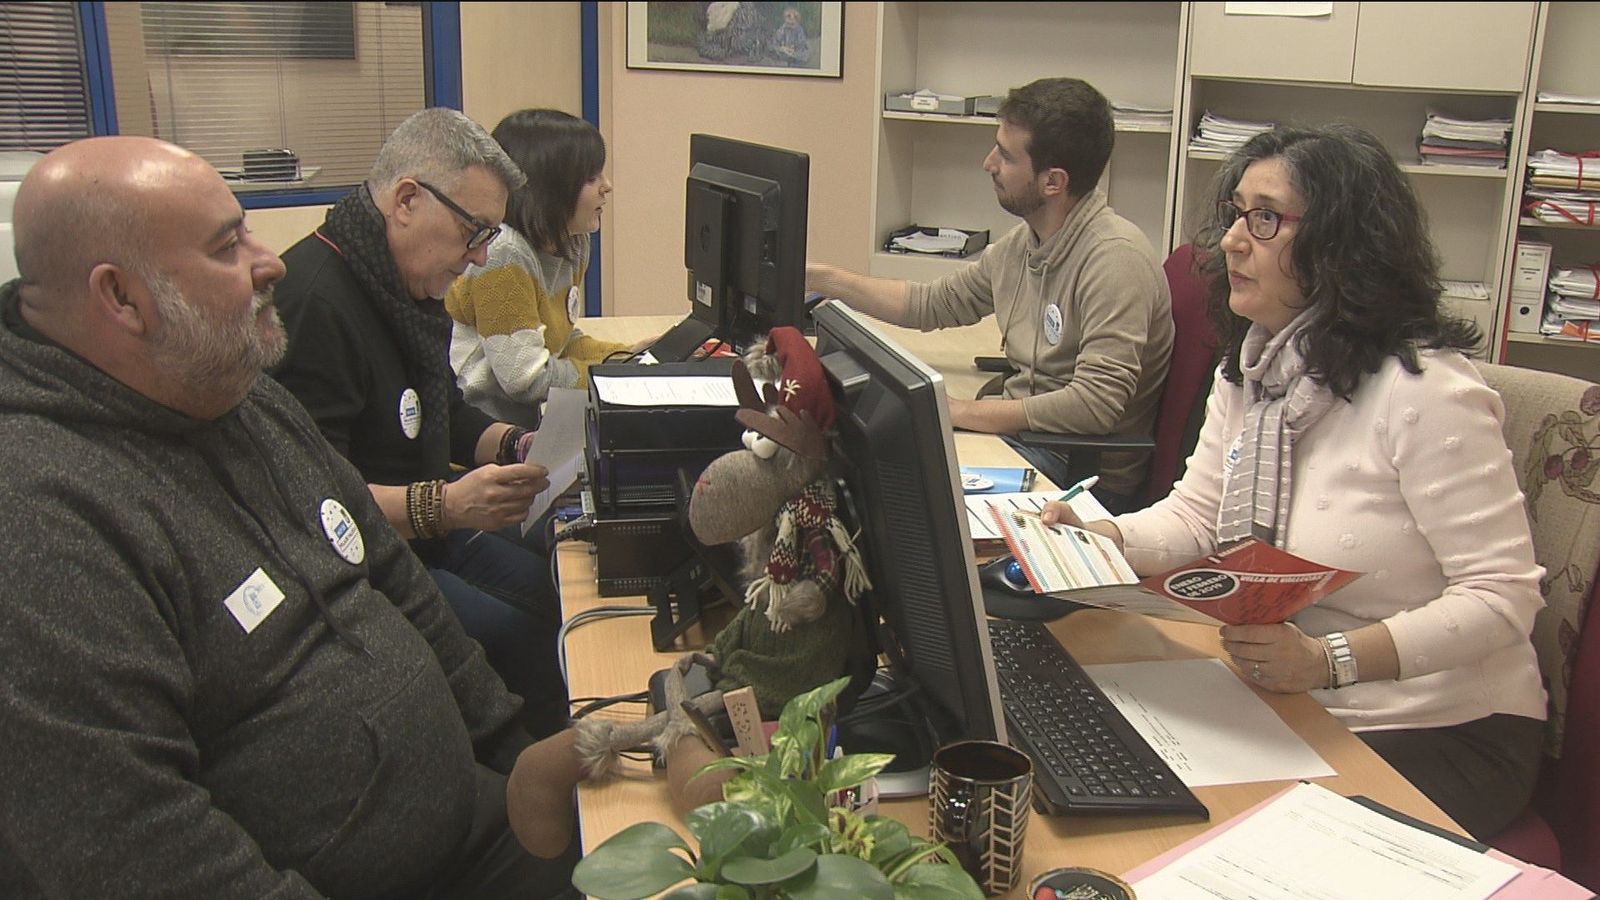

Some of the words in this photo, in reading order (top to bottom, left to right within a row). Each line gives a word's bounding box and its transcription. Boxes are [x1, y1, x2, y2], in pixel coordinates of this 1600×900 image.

[1170, 576, 1202, 590] ENERO
[1186, 574, 1228, 591] FEBRERO
[1240, 575, 1265, 583] VILLA
[1198, 583, 1223, 594] 2019
